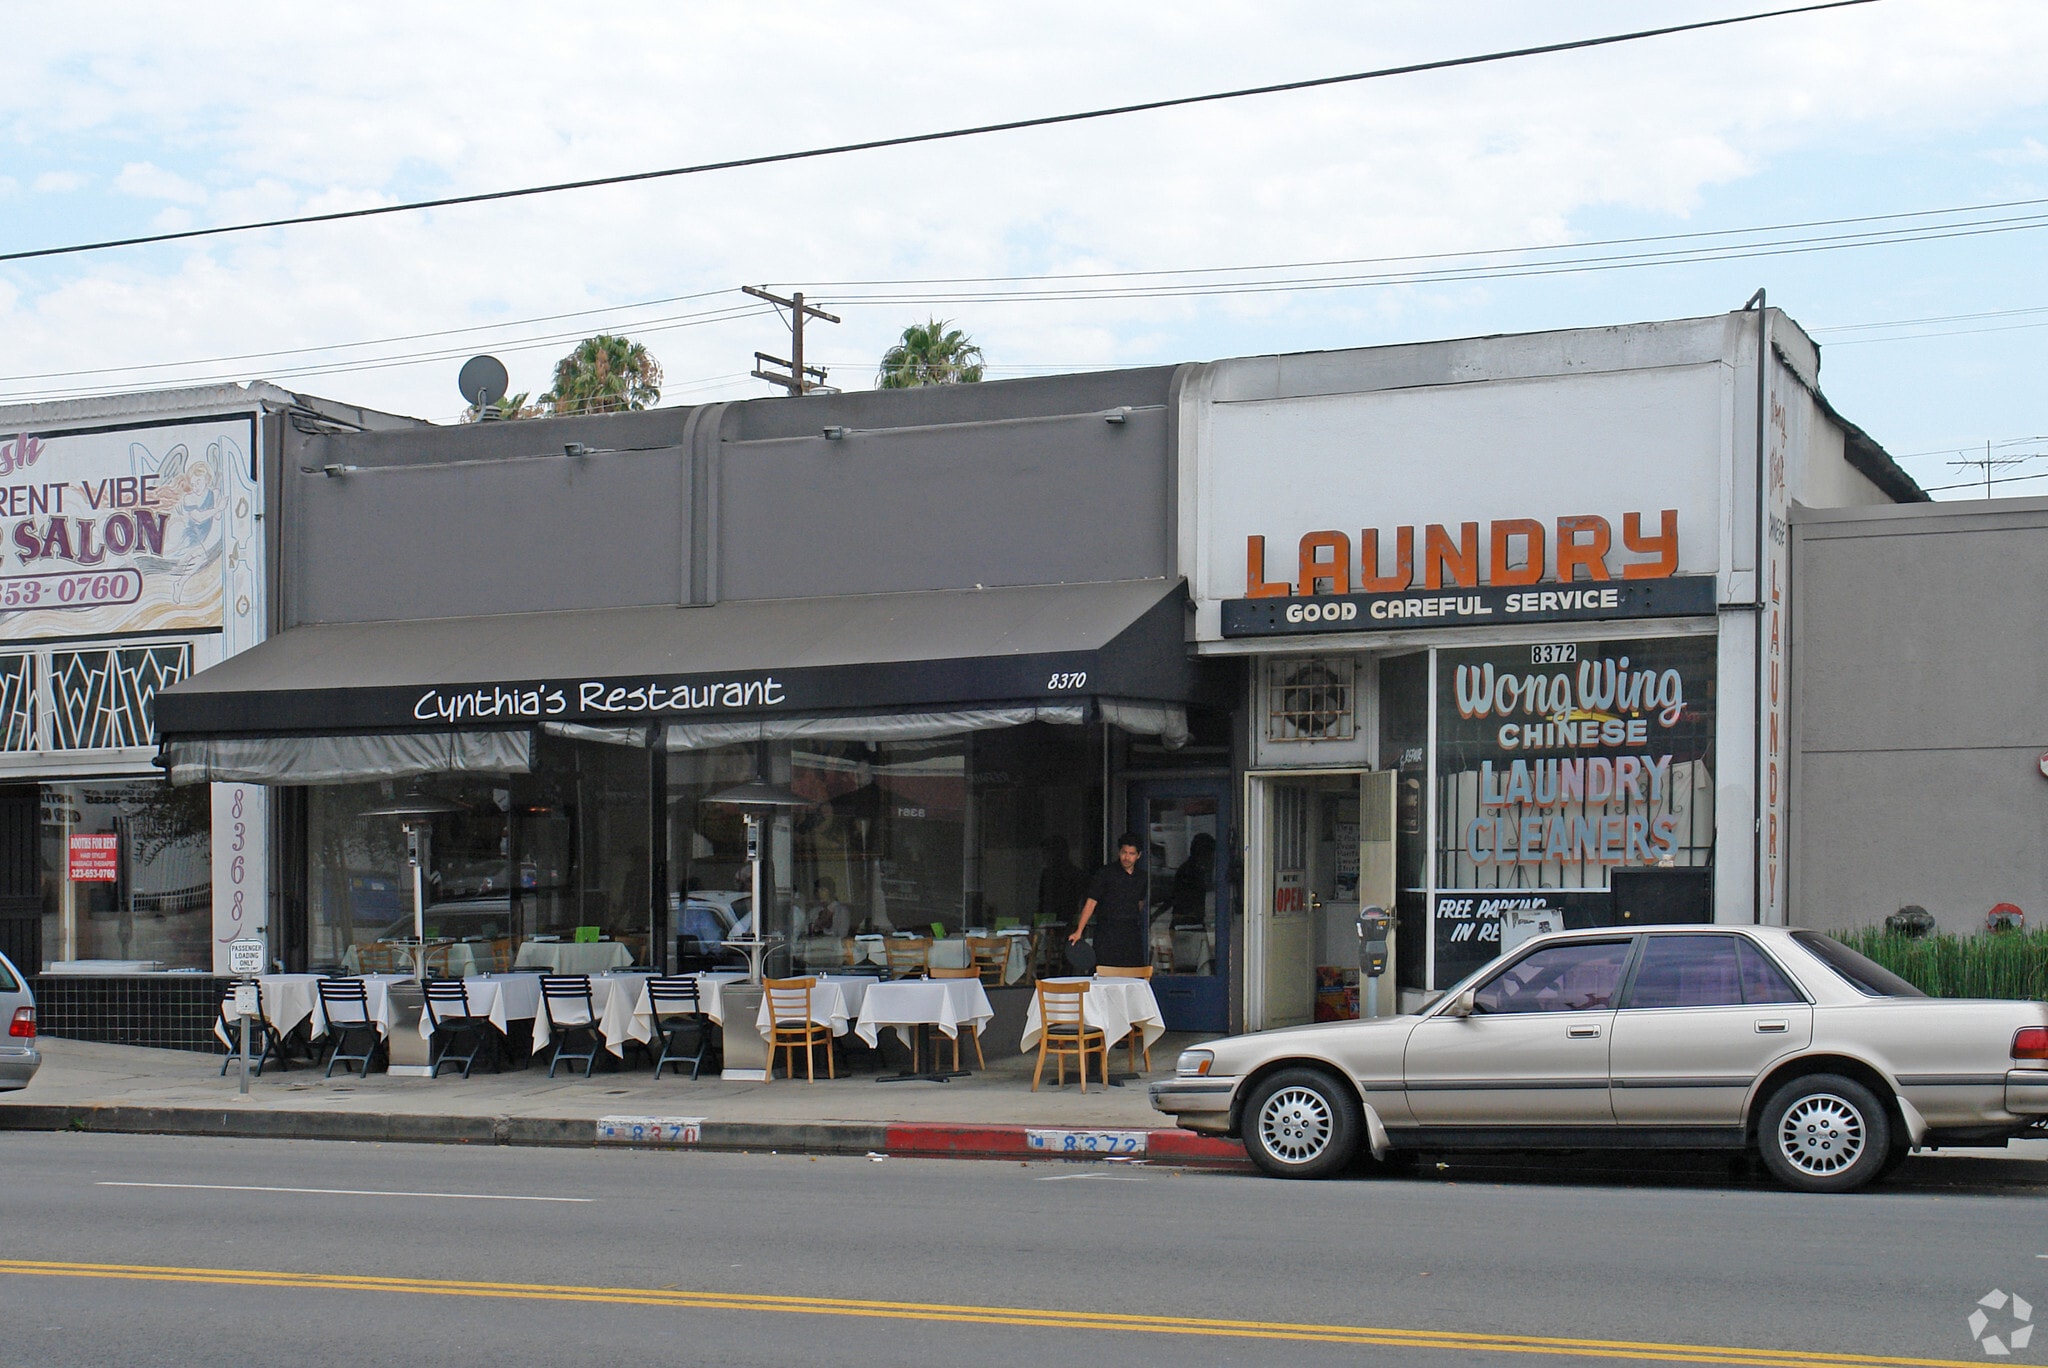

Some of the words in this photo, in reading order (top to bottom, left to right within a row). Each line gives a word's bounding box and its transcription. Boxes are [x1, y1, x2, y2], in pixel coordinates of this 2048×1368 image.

[82, 474, 161, 510] VIBE
[12, 508, 170, 567] SALON
[1245, 509, 1679, 598] LAUNDRY
[0, 574, 129, 605] 53-0760
[1285, 602, 1358, 625] GOOD
[1370, 596, 1493, 619] CAREFUL
[1504, 588, 1619, 614] SERVICE
[1532, 645, 1576, 663] 8372
[1047, 671, 1087, 690] 8370
[1454, 662, 1578, 725] Wong
[1576, 656, 1687, 728] Wing
[413, 684, 567, 723] Cynthia's
[579, 677, 786, 712] Restaurant
[1498, 719, 1648, 750] CHINESE
[1480, 754, 1673, 809] LAUNDRY
[231, 789, 246, 921] 8368
[1465, 815, 1680, 867] CLEANERS
[1277, 887, 1304, 912] OPEN
[1437, 899, 1474, 918] FREE
[1450, 922, 1476, 942] IN
[1063, 1135, 1137, 1151] 8372
